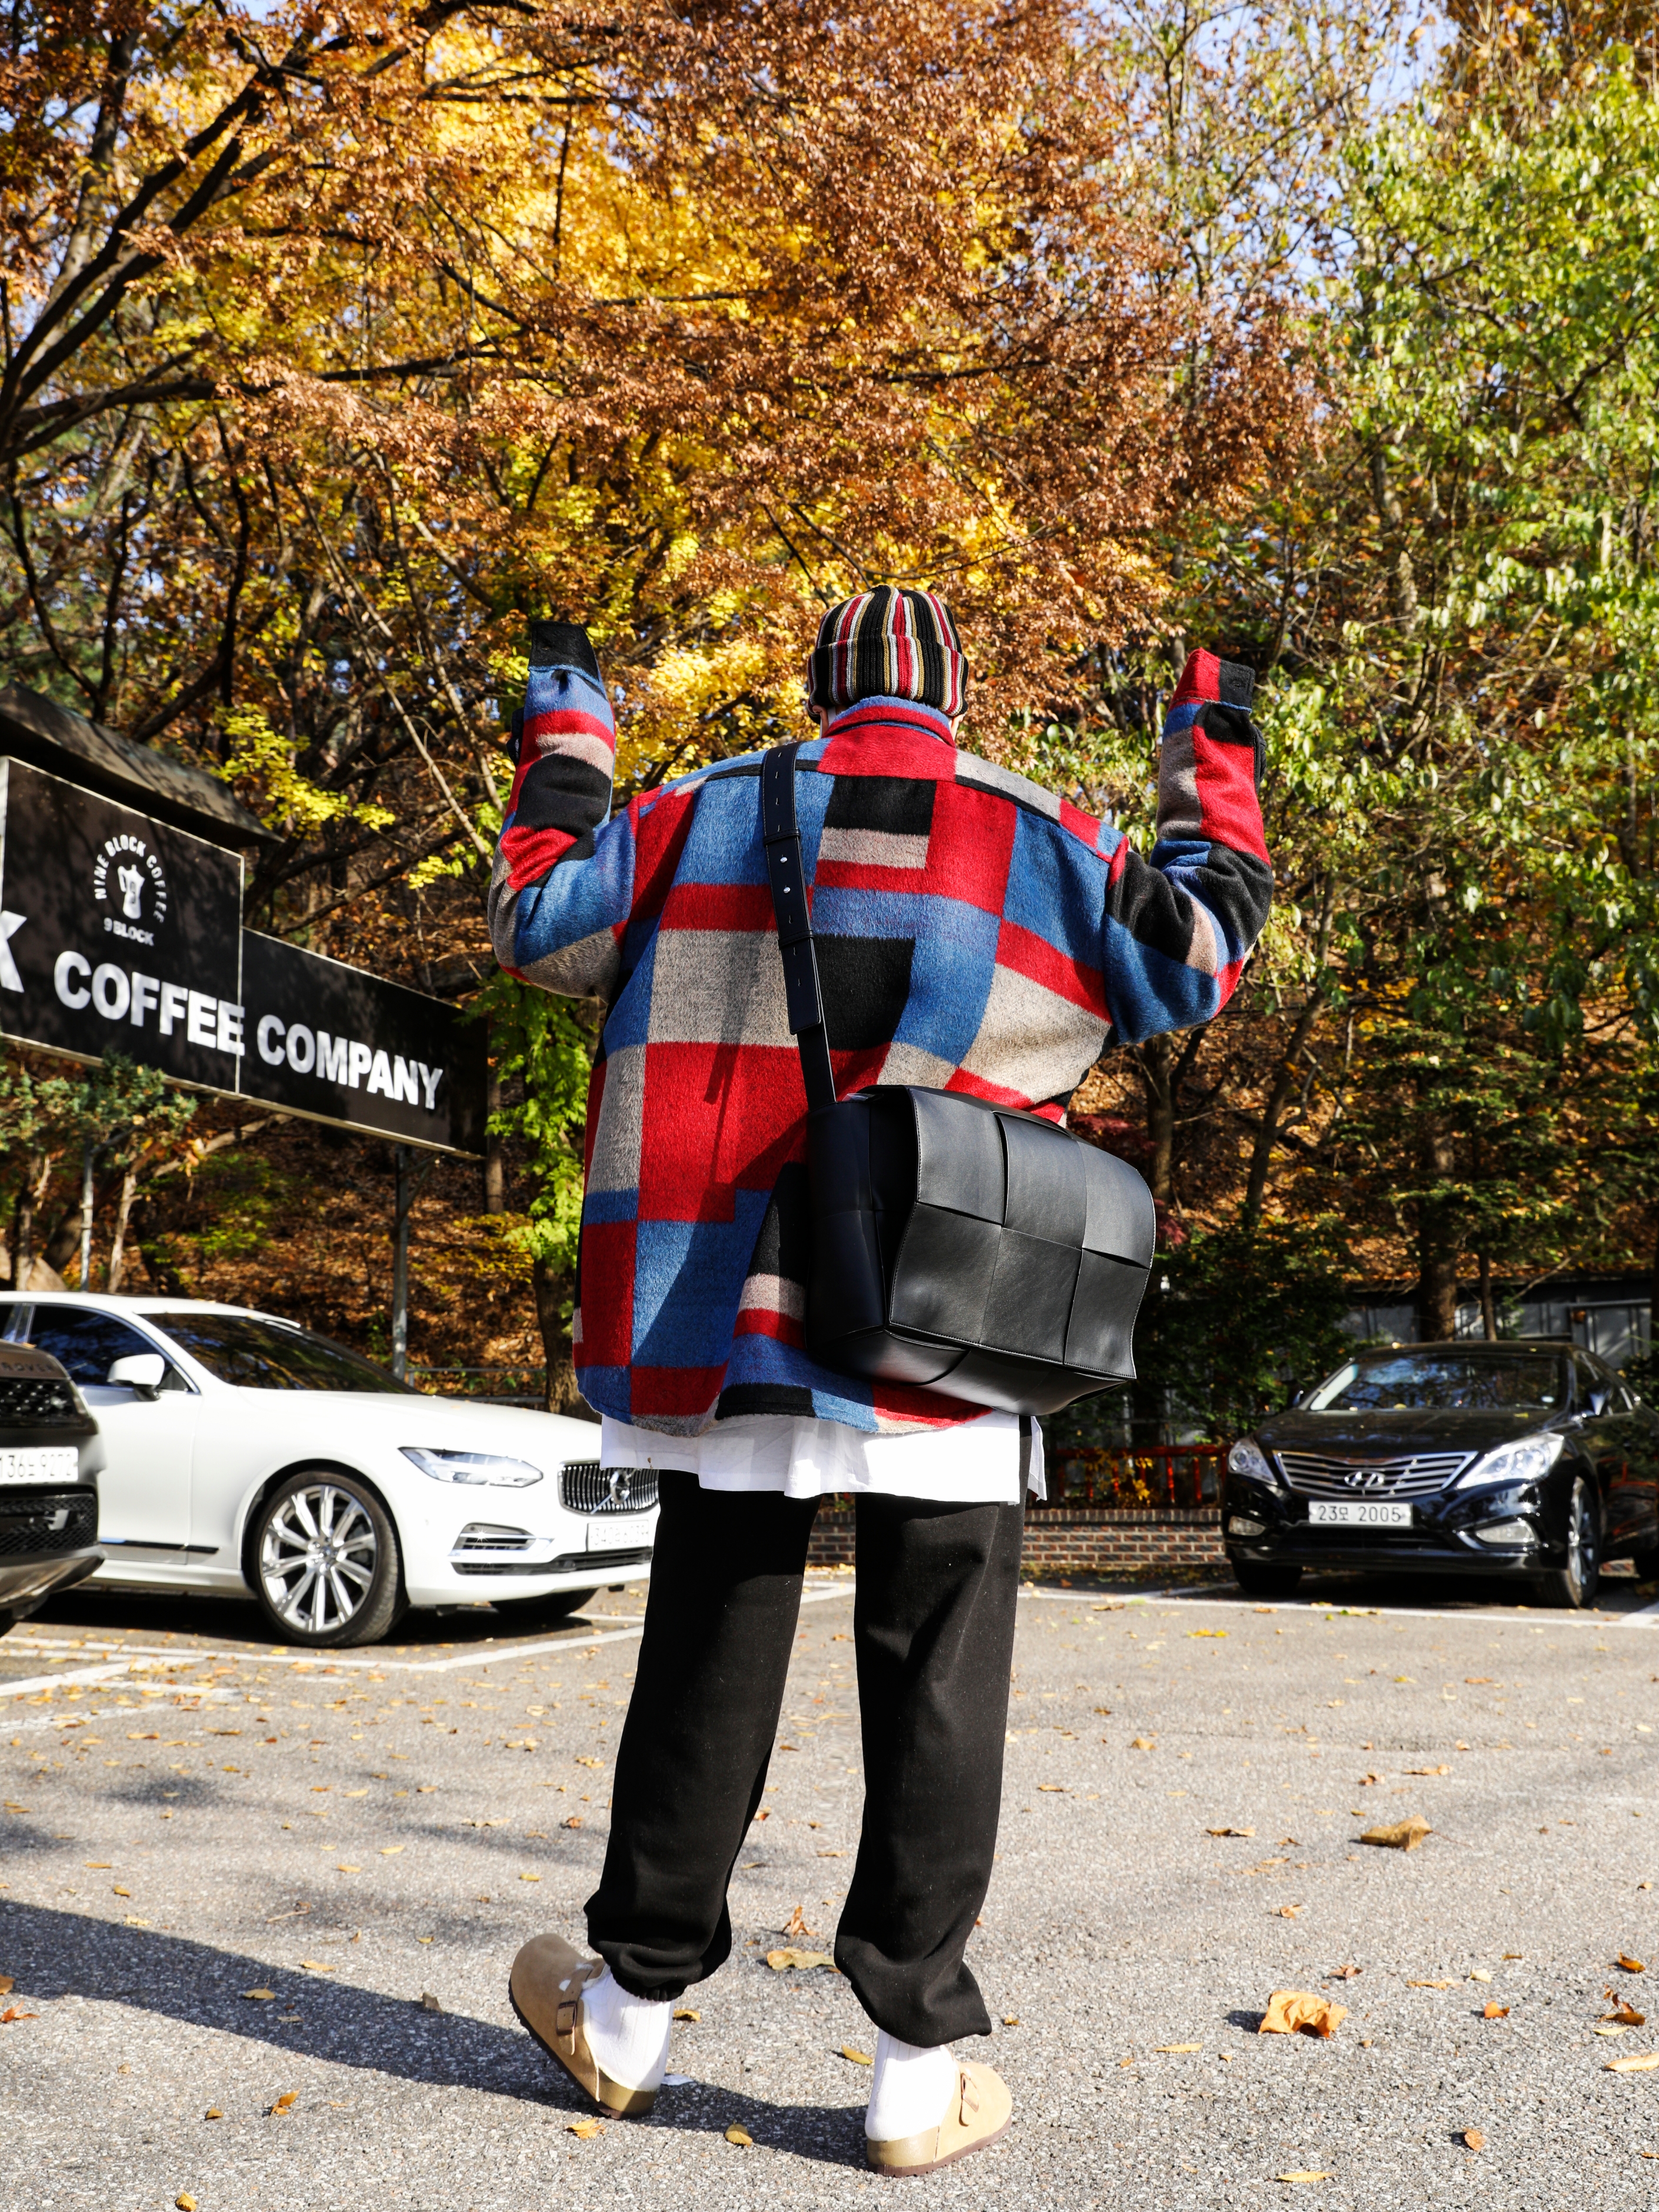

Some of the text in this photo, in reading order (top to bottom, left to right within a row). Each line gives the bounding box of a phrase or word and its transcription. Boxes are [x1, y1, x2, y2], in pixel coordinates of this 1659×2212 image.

[94, 834, 166, 923] NINE BLOCK COFFEE
[104, 917, 155, 947] 9 BLOCK
[54, 951, 245, 1057] COFFEE
[257, 1014, 443, 1110] COMPANY
[40, 1454, 72, 1476] 9272
[1358, 1506, 1401, 1522] 2005
